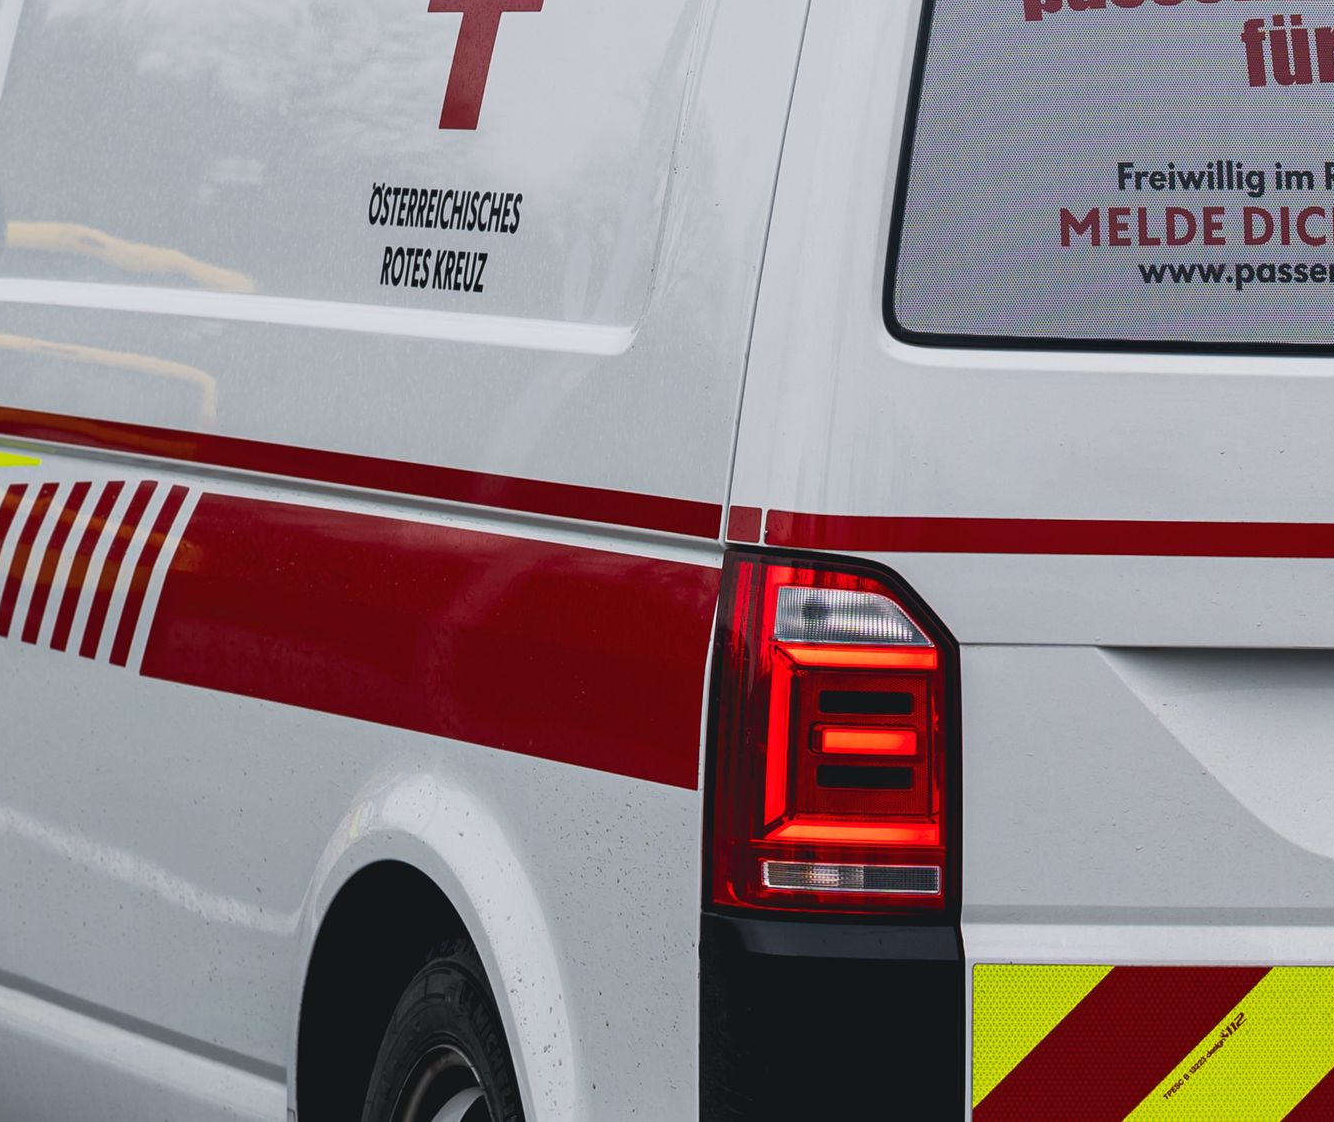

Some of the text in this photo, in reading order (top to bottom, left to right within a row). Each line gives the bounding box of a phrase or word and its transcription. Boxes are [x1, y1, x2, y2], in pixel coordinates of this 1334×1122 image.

[1116, 160, 1266, 198] Freiwillig
[1274, 161, 1315, 191] im
[367, 182, 524, 235] ÖSTERREICHISCHES
[1059, 206, 1227, 247] MELDE
[379, 245, 489, 293] ROTES KREUZ
